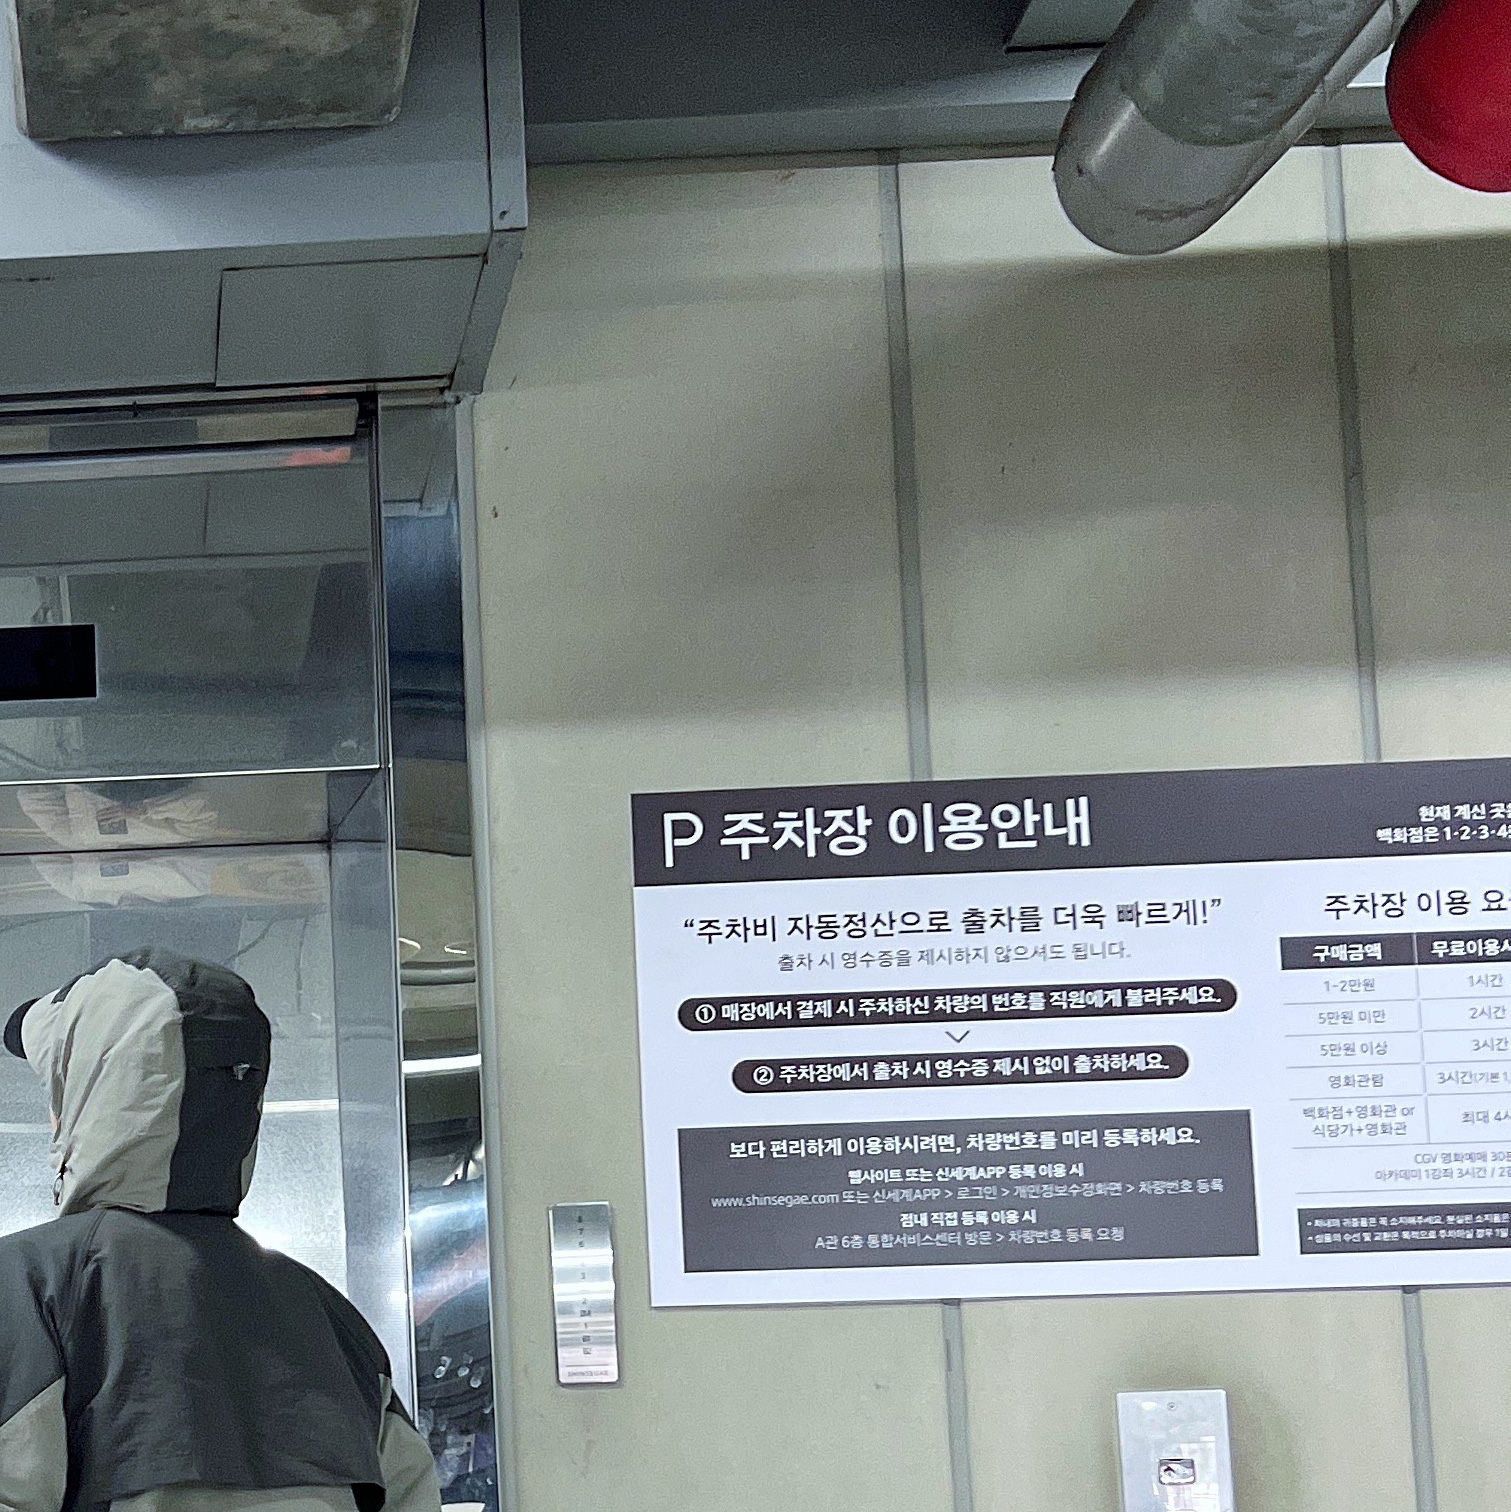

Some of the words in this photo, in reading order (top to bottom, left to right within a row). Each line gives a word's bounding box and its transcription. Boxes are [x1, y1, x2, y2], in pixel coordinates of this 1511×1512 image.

[1418, 804, 1451, 822] 현재
[1453, 802, 1486, 820] 계신
[1489, 802, 1511, 820] 곳
[661, 811, 704, 868] P
[719, 804, 873, 861] 주차장
[887, 795, 1090, 854] 이용안내
[1376, 826, 1440, 844] 백화점은
[1324, 891, 1407, 920] 주차장
[1417, 889, 1471, 916] 이용
[683, 915, 777, 944] “주차비
[787, 910, 952, 942] 자동정산으로
[960, 904, 1043, 934] 출차를
[1053, 902, 1106, 930] 더욱
[777, 952, 813, 971] 출차
[818, 951, 835, 970] 시
[841, 948, 912, 969] 영수증을
[917, 946, 989, 967] 제시하지
[994, 943, 1067, 964] 않으셔도
[1071, 940, 1132, 960] 됩니다.
[1312, 942, 1382, 962] 구매금액
[1323, 977, 1376, 993] 1-2만원
[1467, 973, 1504, 988] 1시간
[721, 1002, 792, 1022] 매장에서
[796, 1000, 832, 1019] 결제
[836, 998, 854, 1017] 시
[858, 995, 930, 1016] 주차하신
[934, 993, 988, 1014] 차량의
[992, 992, 1047, 1012] 번호를
[1050, 989, 1122, 1010] 직원에게
[1125, 985, 1222, 1006] 불러주세요.
[1469, 1005, 1507, 1020] 2시간
[1318, 1010, 1353, 1025] 5만원
[1358, 1009, 1386, 1024] 미만
[1320, 1042, 1356, 1057] 5만원
[1360, 1041, 1388, 1056] 이상
[1472, 1037, 1509, 1052] 3시간
[779, 1063, 869, 1084] 주차장에서
[873, 1061, 909, 1081] 출차
[912, 1060, 931, 1078] 시
[934, 1058, 989, 1079] 영수증
[992, 1056, 1030, 1076] 제시
[1033, 1055, 1069, 1075] 없이
[1073, 1052, 1170, 1073] 출차하세요.
[1328, 1073, 1385, 1089] 영화관람
[1401, 1106, 1415, 1116] or
[1462, 1109, 1490, 1124] 최대
[729, 1139, 766, 1159] 보다
[770, 1137, 842, 1159] 편리하게
[846, 1133, 961, 1155] 이용하시려면,
[966, 1131, 1058, 1151] 차량번호를
[1062, 1128, 1099, 1148] 미리
[1103, 1126, 1200, 1147] 등록하세요.
[1414, 1152, 1437, 1164] CGV
[847, 1169, 903, 1185] 웹사이트
[905, 1168, 933, 1183] 또는
[936, 1165, 1006, 1182] 신세계APP
[1008, 1164, 1036, 1179] 등록
[1038, 1163, 1066, 1178] 이용
[1069, 1162, 1085, 1178] 시
[1457, 1167, 1488, 1179] 3시간
[710, 1192, 839, 1208] www.shinsegae.com
[842, 1190, 870, 1204] 또는
[872, 1187, 939, 1204] 신세계APP
[957, 1186, 997, 1200] 로그인
[1196, 1178, 1224, 1193] 등록
[899, 1212, 928, 1228] 점내
[930, 1211, 958, 1227] 직접
[961, 1210, 989, 1226] 등록
[991, 1210, 1019, 1224] 이용
[1022, 1208, 1037, 1224] 시
[814, 1235, 839, 1250] A관
[841, 1234, 863, 1249] 6층
[866, 1232, 962, 1249] 통합서비스센터
[964, 1231, 992, 1246] 방문
[1008, 1229, 1063, 1245] 차량번호
[1066, 1227, 1094, 1243] 등록
[1096, 1226, 1125, 1242] 요청
